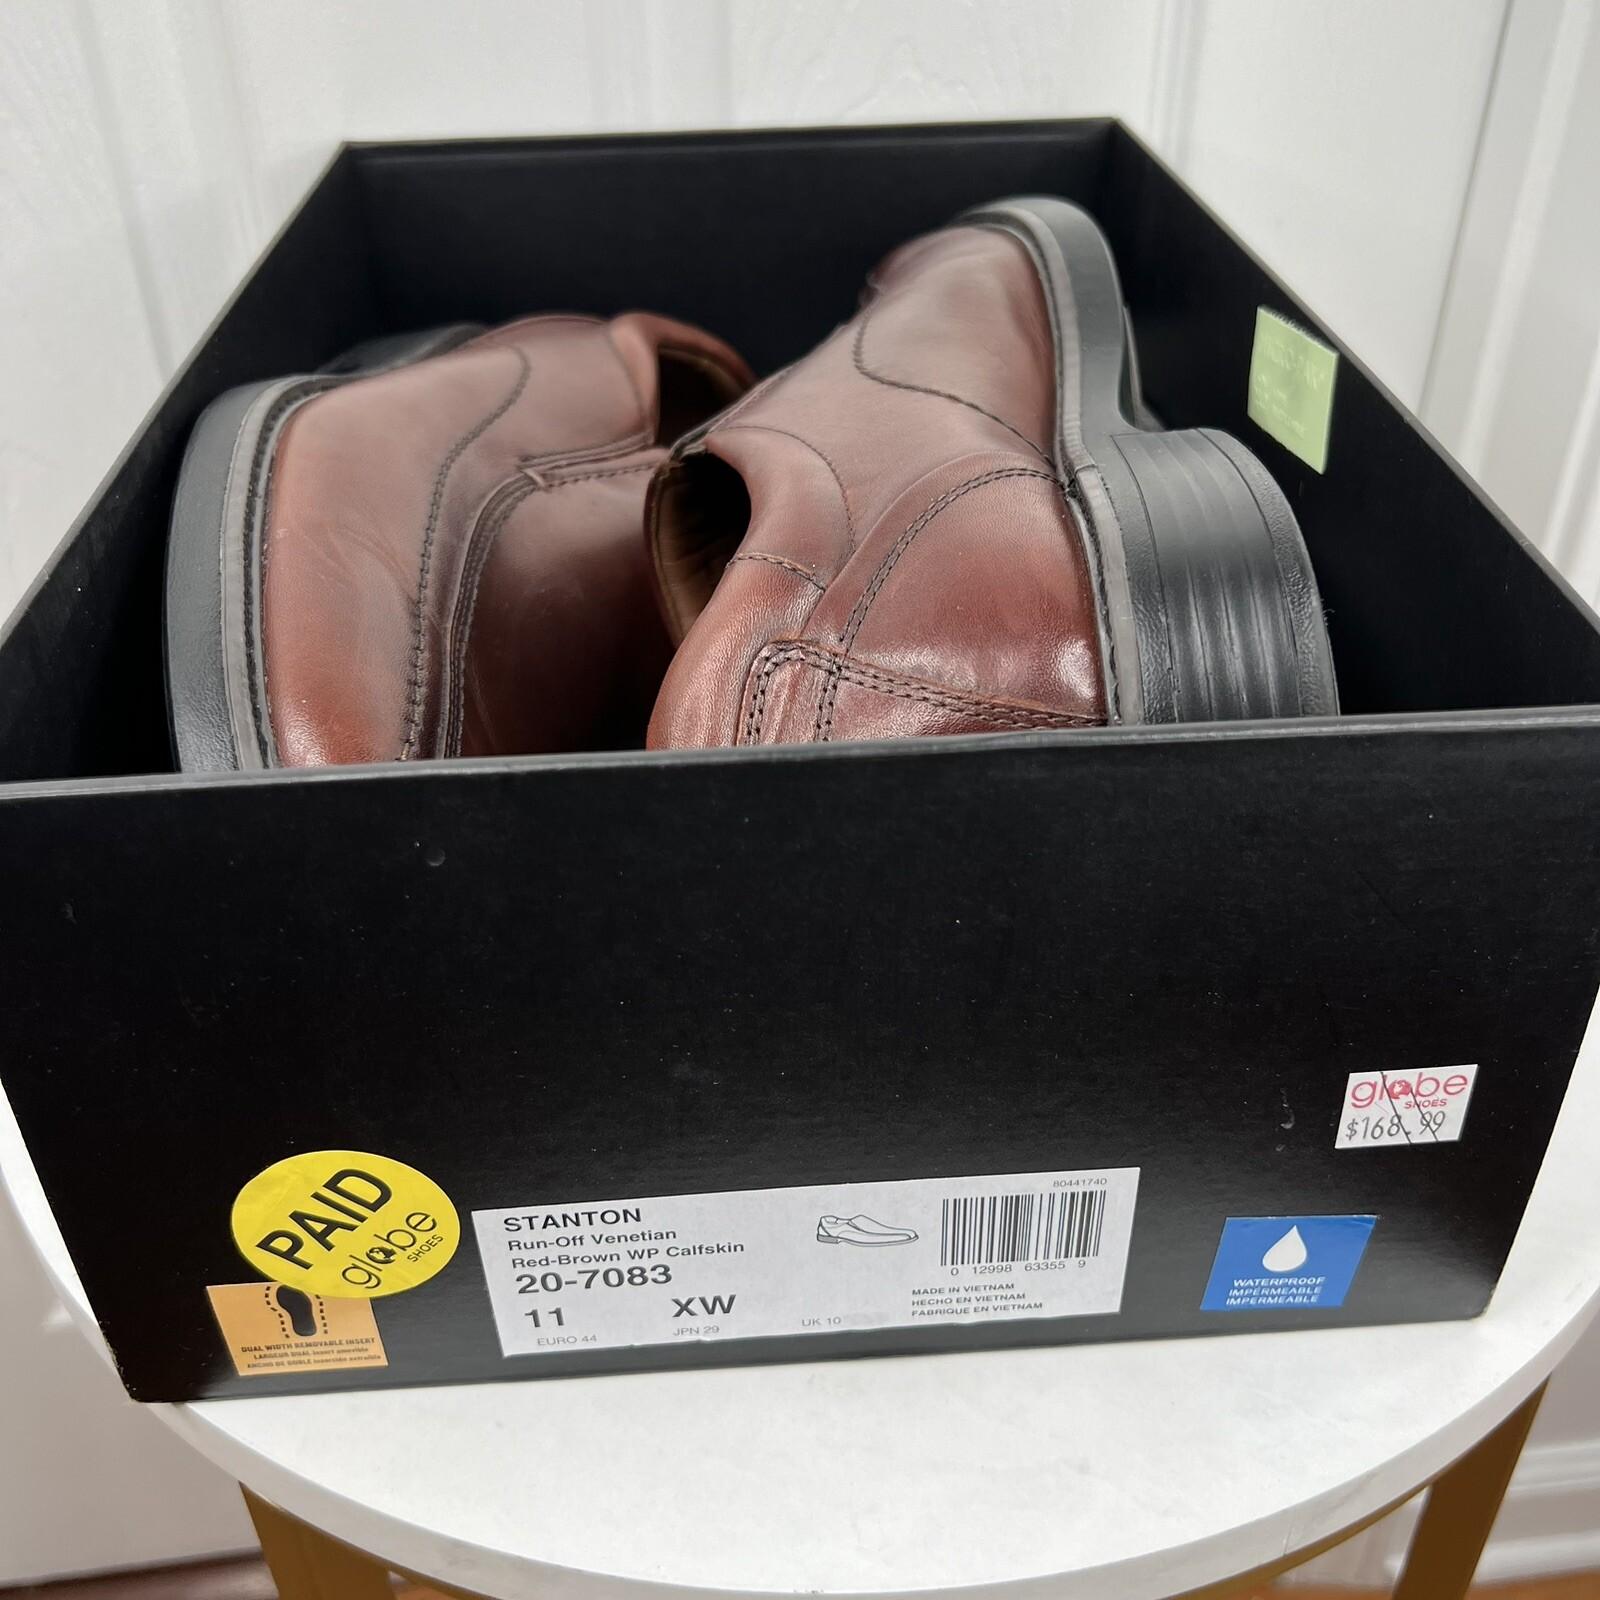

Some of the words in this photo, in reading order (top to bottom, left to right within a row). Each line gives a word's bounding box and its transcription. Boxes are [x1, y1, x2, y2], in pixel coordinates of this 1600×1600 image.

[1350, 1071, 1468, 1109] globe
[1404, 1098, 1448, 1109] SHOES
[1346, 1110, 1446, 1141] $168.99
[1053, 1177, 1108, 1188] 80441740
[255, 1168, 393, 1270] PAID
[503, 1208, 642, 1232] STANTON
[406, 1234, 444, 1263] SHOES
[508, 1234, 585, 1251] Run-Off
[591, 1229, 677, 1244] Venetian
[341, 1211, 437, 1289] globe
[512, 1251, 621, 1269] Red-Brown
[627, 1248, 660, 1260] WP
[666, 1242, 745, 1257] Calfskin
[950, 1268, 959, 1277] 0
[973, 1264, 1013, 1275] 12998
[1024, 1262, 1066, 1272] 63355
[1078, 1260, 1086, 1269] 9
[515, 1264, 673, 1294] 20-7083
[1233, 1277, 1326, 1287] WATERPROOF
[912, 1287, 945, 1296] MADE
[963, 1283, 1015, 1293] VIETNAM
[912, 1297, 953, 1306] HECHO
[975, 1292, 1026, 1302] VIETNAM
[1226, 1295, 1319, 1305] IMPERMEABLE
[524, 1307, 566, 1329] 11
[671, 1294, 737, 1318] XW
[911, 1306, 970, 1317] FABRIQUE
[973, 1305, 989, 1313] EN
[992, 1302, 1043, 1312] VIETNAM
[801, 1317, 822, 1327] UK
[827, 1316, 842, 1325] 10
[672, 1325, 700, 1336] JPN
[703, 1325, 720, 1334] 29
[536, 1335, 578, 1346] EURO
[582, 1334, 598, 1343] 44
